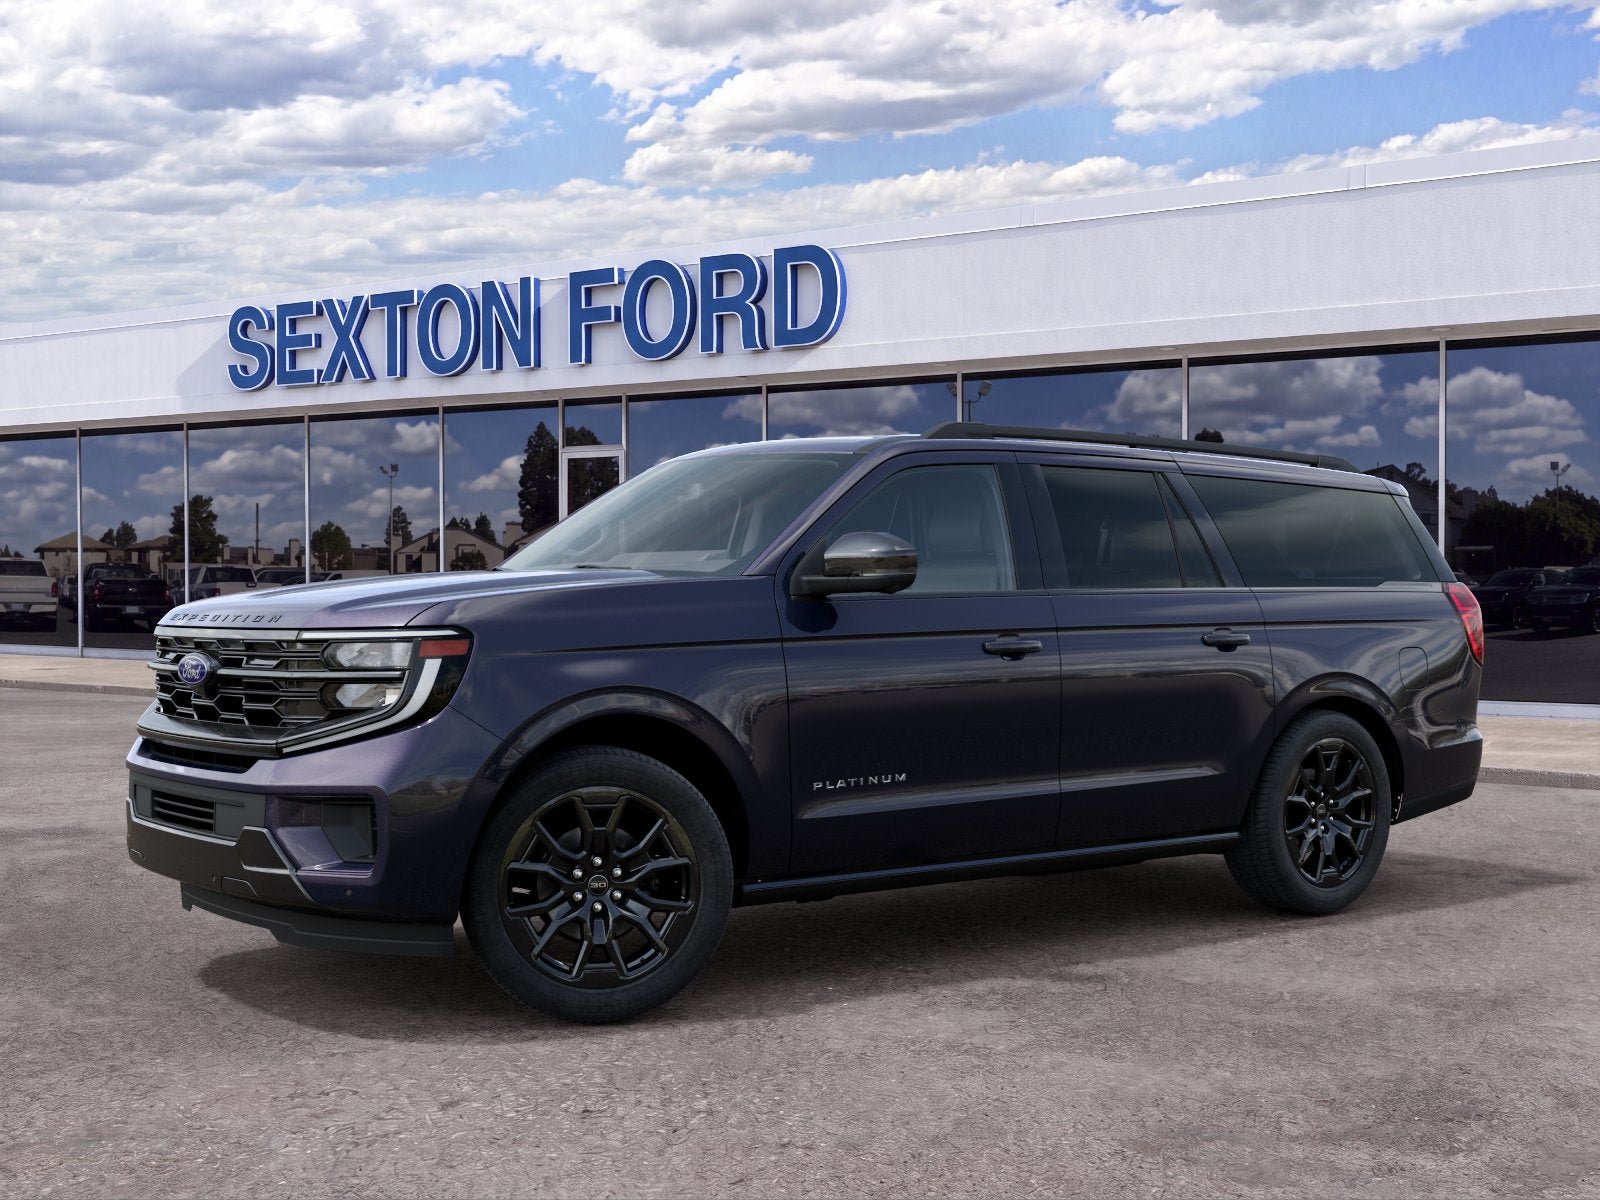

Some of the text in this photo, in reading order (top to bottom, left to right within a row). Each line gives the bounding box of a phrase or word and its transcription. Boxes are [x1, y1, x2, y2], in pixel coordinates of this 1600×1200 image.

[227, 244, 847, 391] SEXTON FORD
[169, 612, 283, 623] EXPEDITION
[181, 660, 203, 679] Ford
[812, 773, 907, 791] PLATINUM
